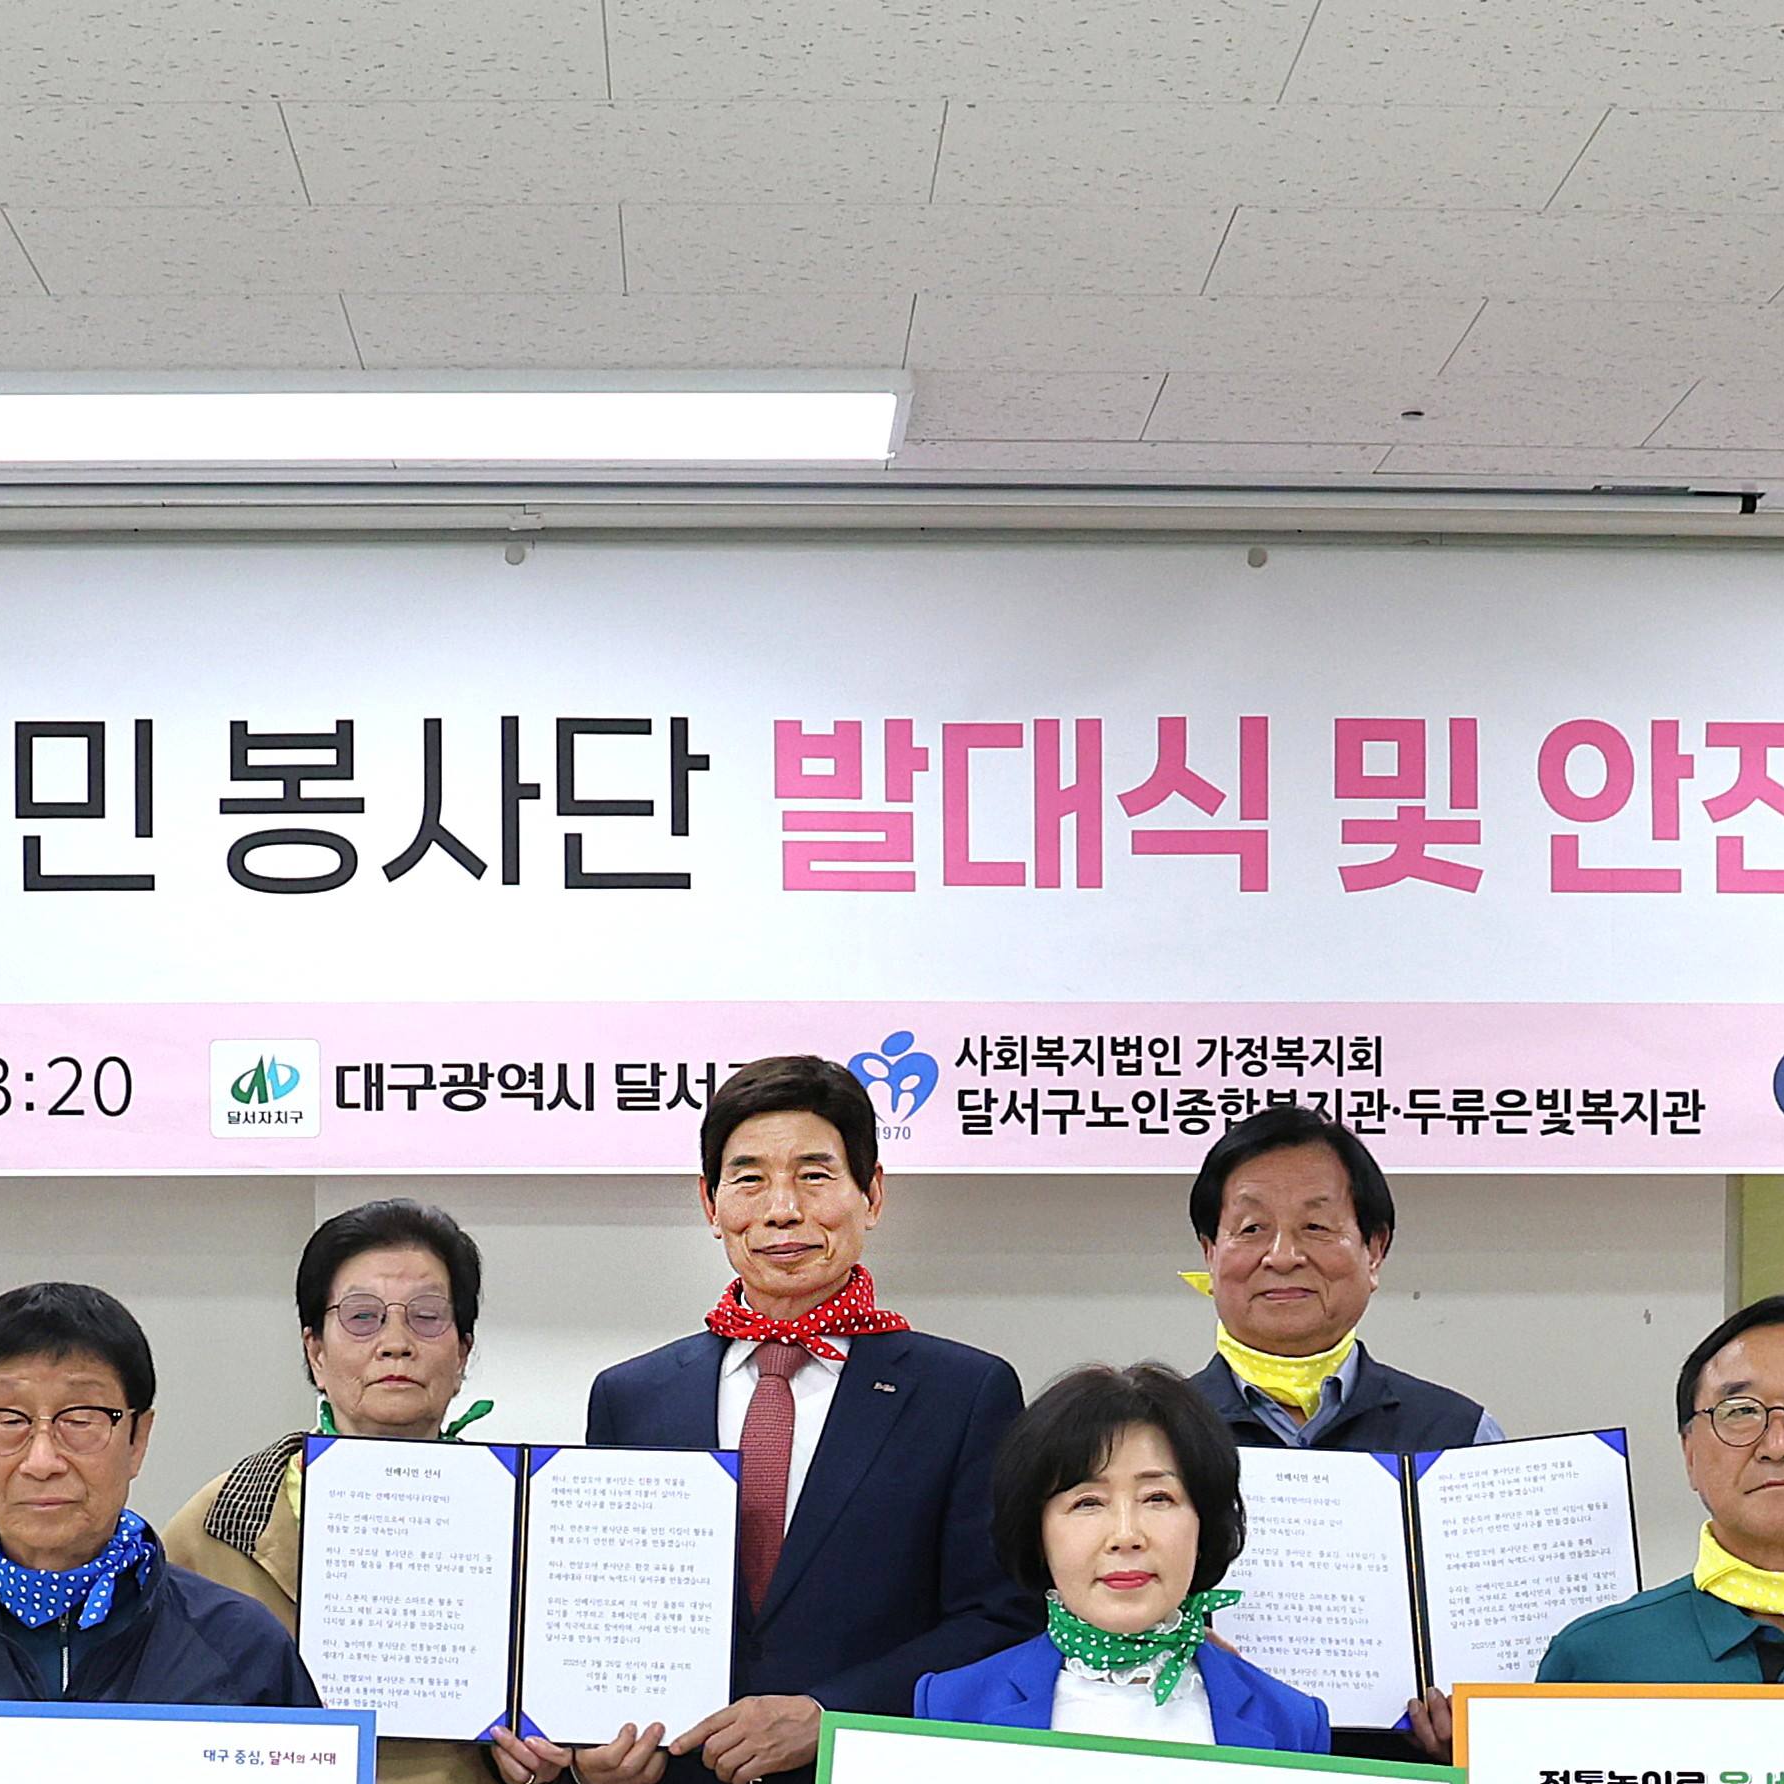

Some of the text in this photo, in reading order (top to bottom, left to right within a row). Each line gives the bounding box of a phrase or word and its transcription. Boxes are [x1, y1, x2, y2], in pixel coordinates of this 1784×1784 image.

[220, 716, 710, 894] 봉사단
[774, 716, 1268, 892] 발대식
[1334, 718, 1483, 893] 및
[955, 1035, 1381, 1077] 사회복지법인 가정복지회
[336, 1058, 725, 1114] 대구광역시 달서
[228, 1111, 303, 1124] 달서자치구
[204, 1750, 336, 1765] 대구 중심, 달서의 시대
